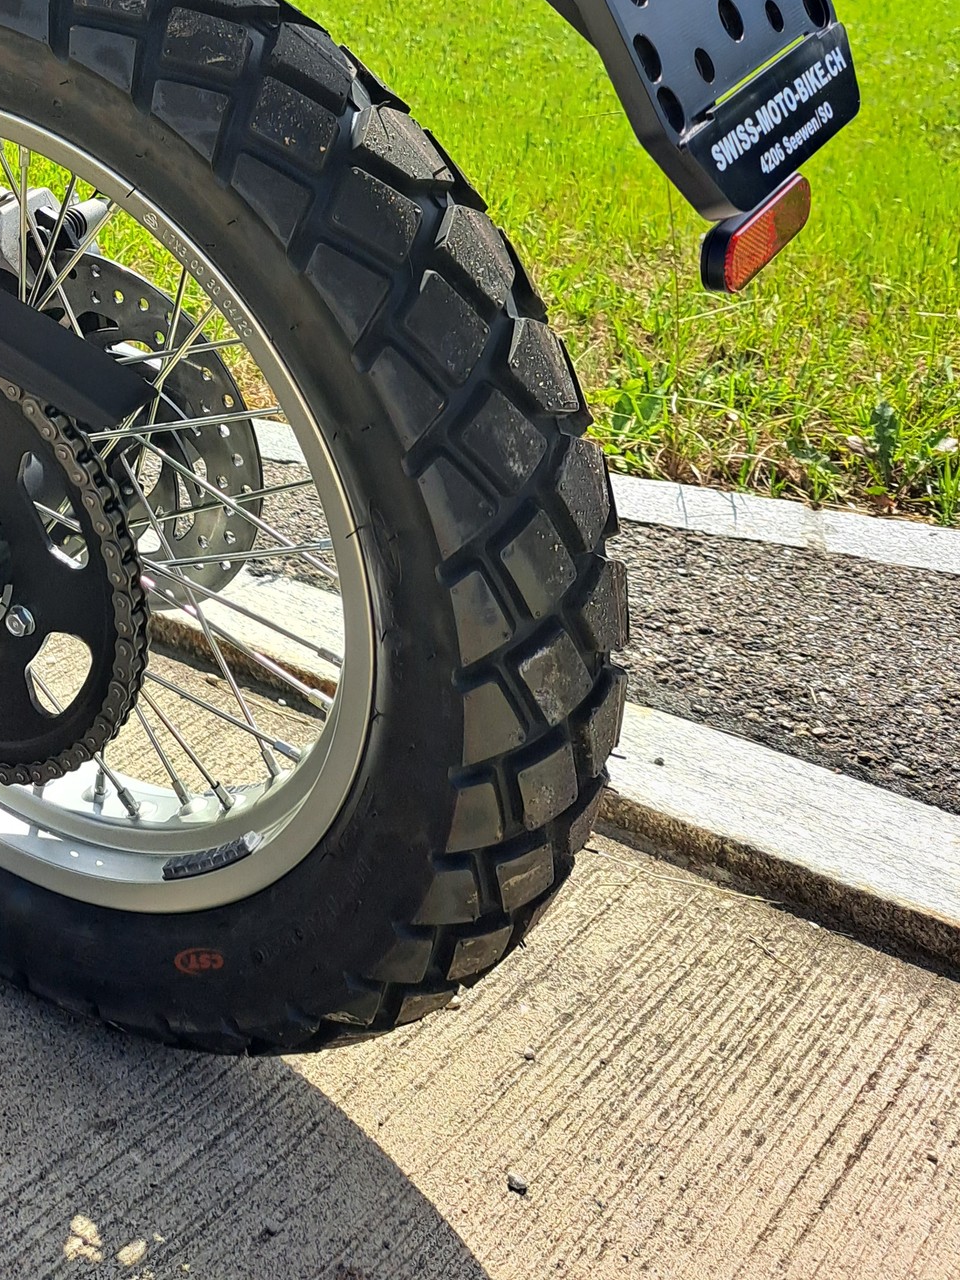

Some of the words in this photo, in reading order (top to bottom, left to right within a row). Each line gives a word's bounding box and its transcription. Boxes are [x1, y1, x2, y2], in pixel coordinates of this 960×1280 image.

[711, 46, 848, 172] SWISS-MOTO-BIKE.CH
[759, 143, 786, 174] 4206
[782, 100, 834, 155] Seewen/SO
[161, 229, 205, 276] 17X3.00
[223, 299, 253, 338] 04/20
[180, 950, 224, 972] CST
